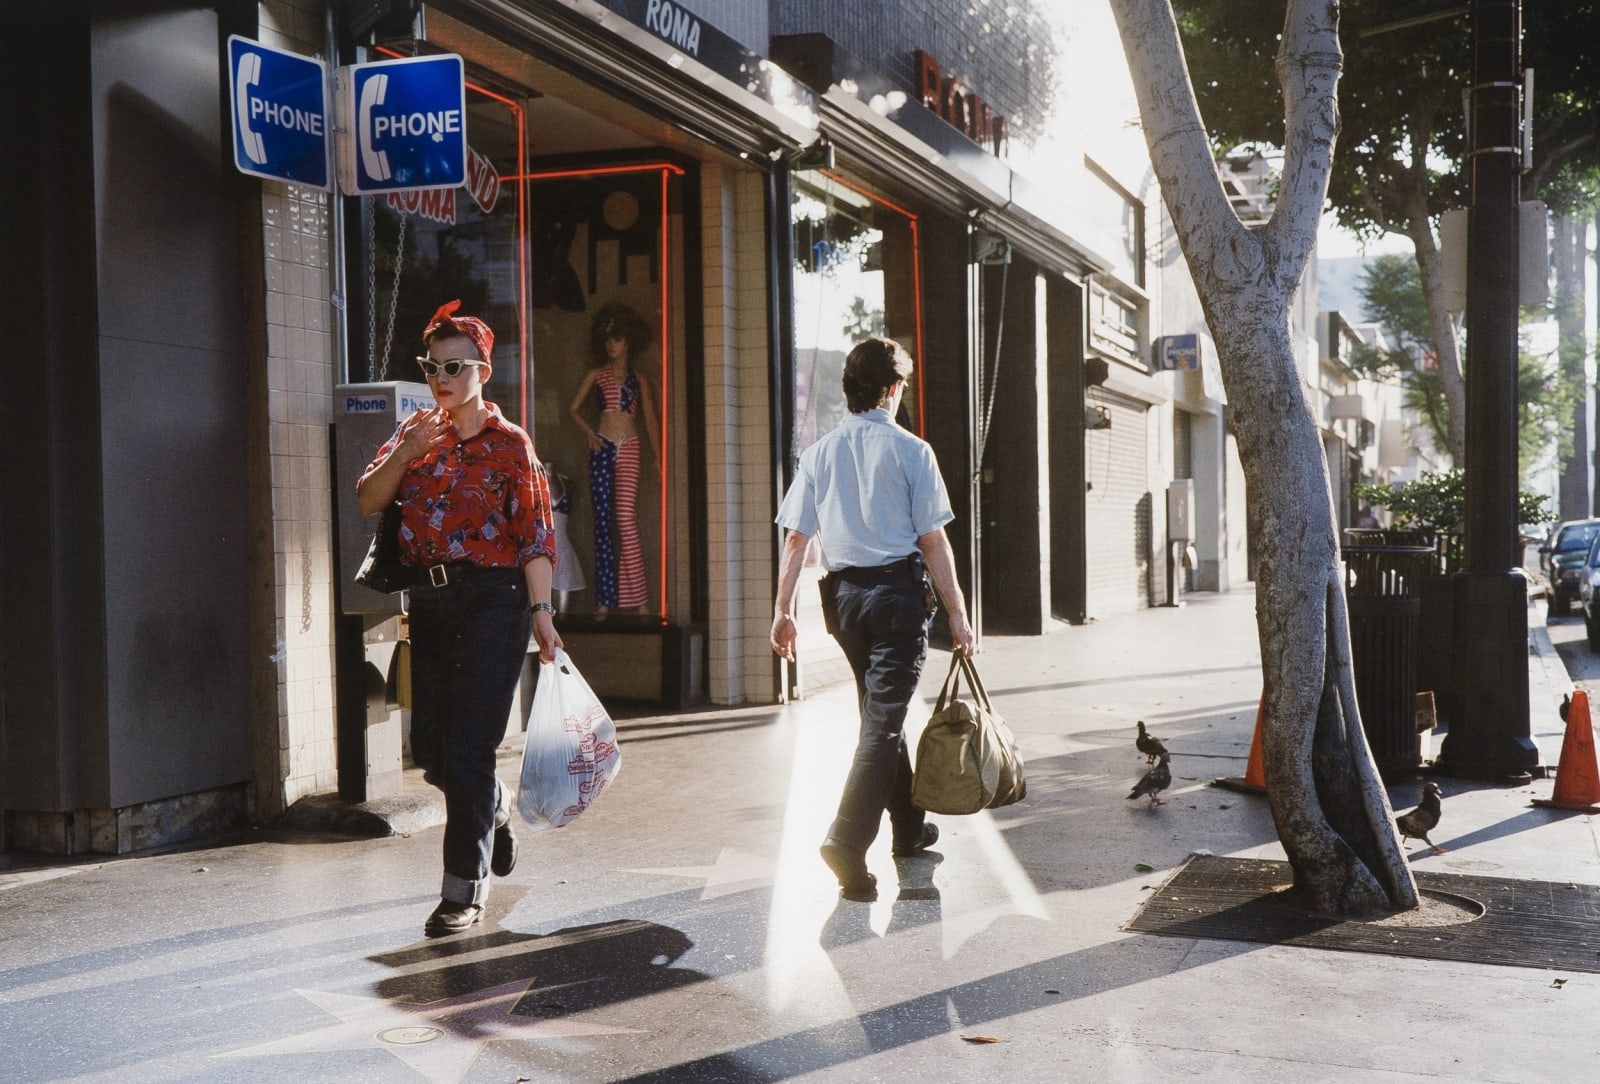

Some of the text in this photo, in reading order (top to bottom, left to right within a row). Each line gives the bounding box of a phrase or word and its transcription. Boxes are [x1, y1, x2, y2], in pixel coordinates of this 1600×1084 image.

[646, 0, 700, 57] ROMA
[251, 97, 323, 136] PHONE
[374, 110, 460, 139] PHONE
[346, 397, 387, 411] Phone
[401, 397, 435, 411] Phon
